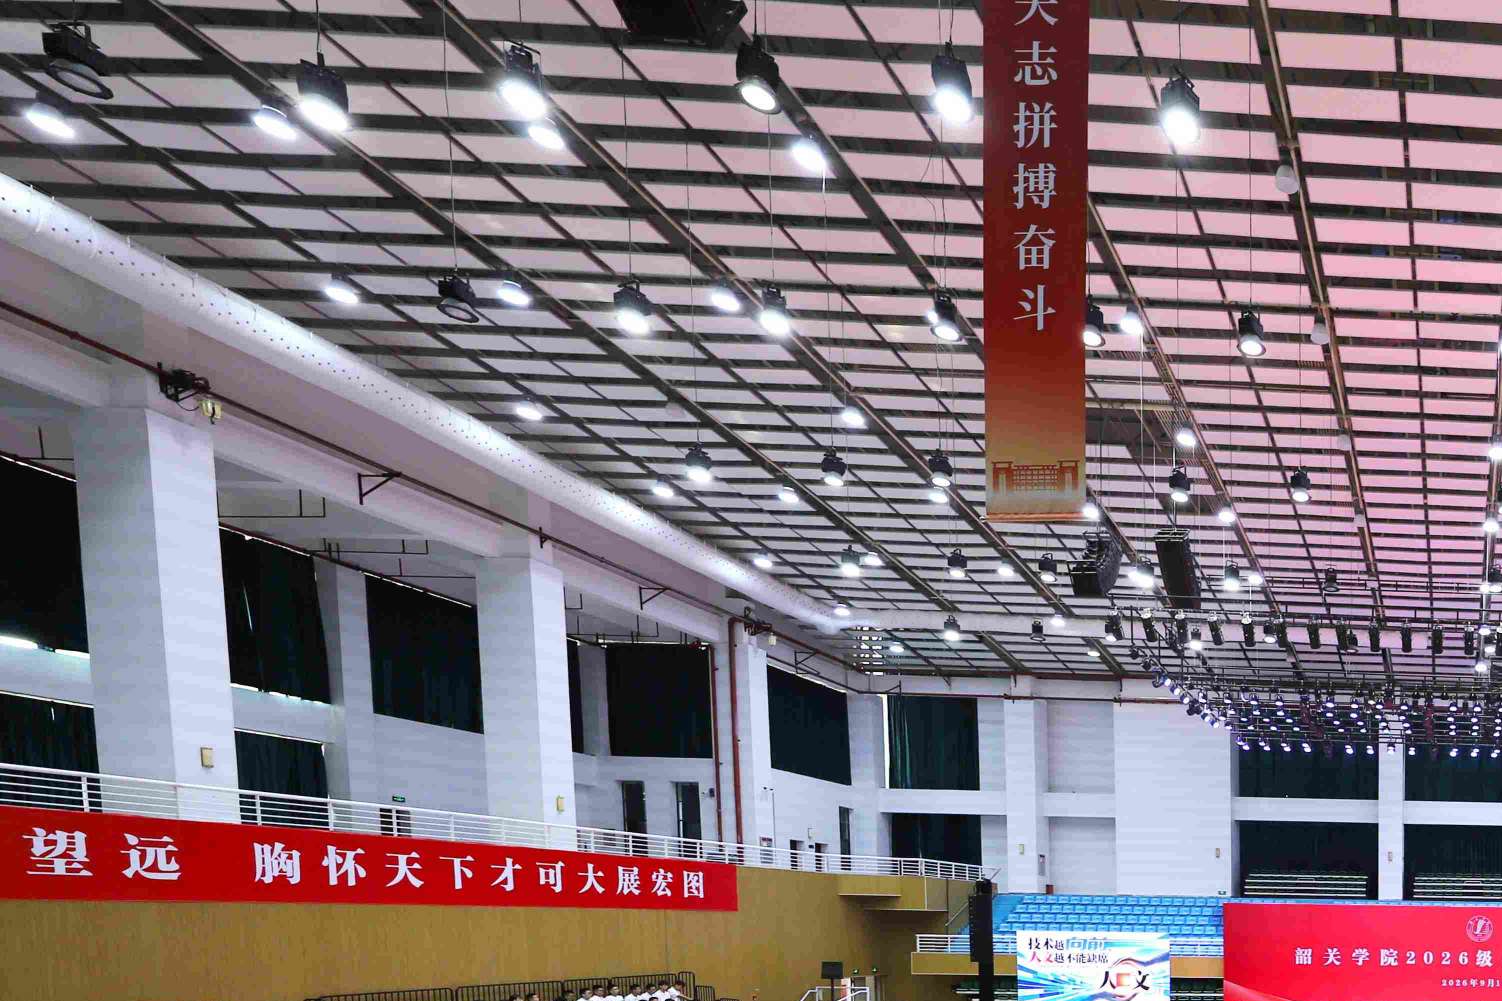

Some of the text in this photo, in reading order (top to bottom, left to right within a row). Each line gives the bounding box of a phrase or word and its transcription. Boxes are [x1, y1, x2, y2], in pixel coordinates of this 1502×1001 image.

[22, 826, 706, 899] 望远 胸怀天下才可大展宏图
